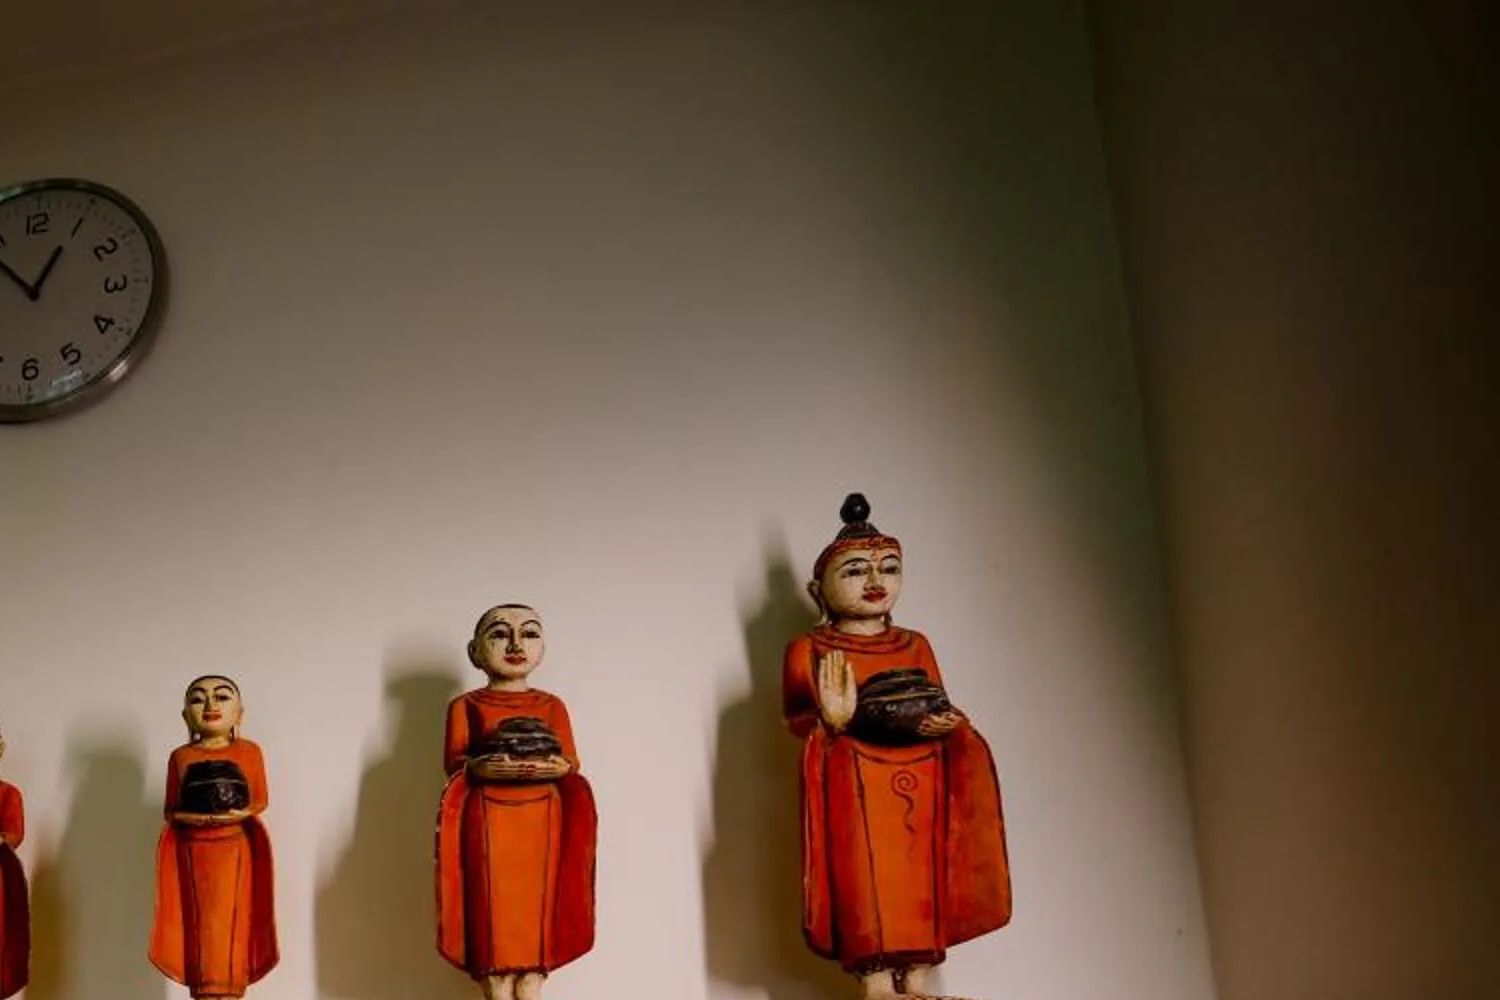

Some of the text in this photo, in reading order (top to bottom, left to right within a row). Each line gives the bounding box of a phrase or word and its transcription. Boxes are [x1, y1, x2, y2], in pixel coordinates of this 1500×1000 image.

[25, 212, 49, 235] 12
[71, 217, 85, 238] 1
[93, 237, 119, 261] 2
[104, 274, 127, 293] 3
[93, 314, 115, 334] 4
[60, 342, 81, 365] 5
[21, 358, 39, 380] 6
